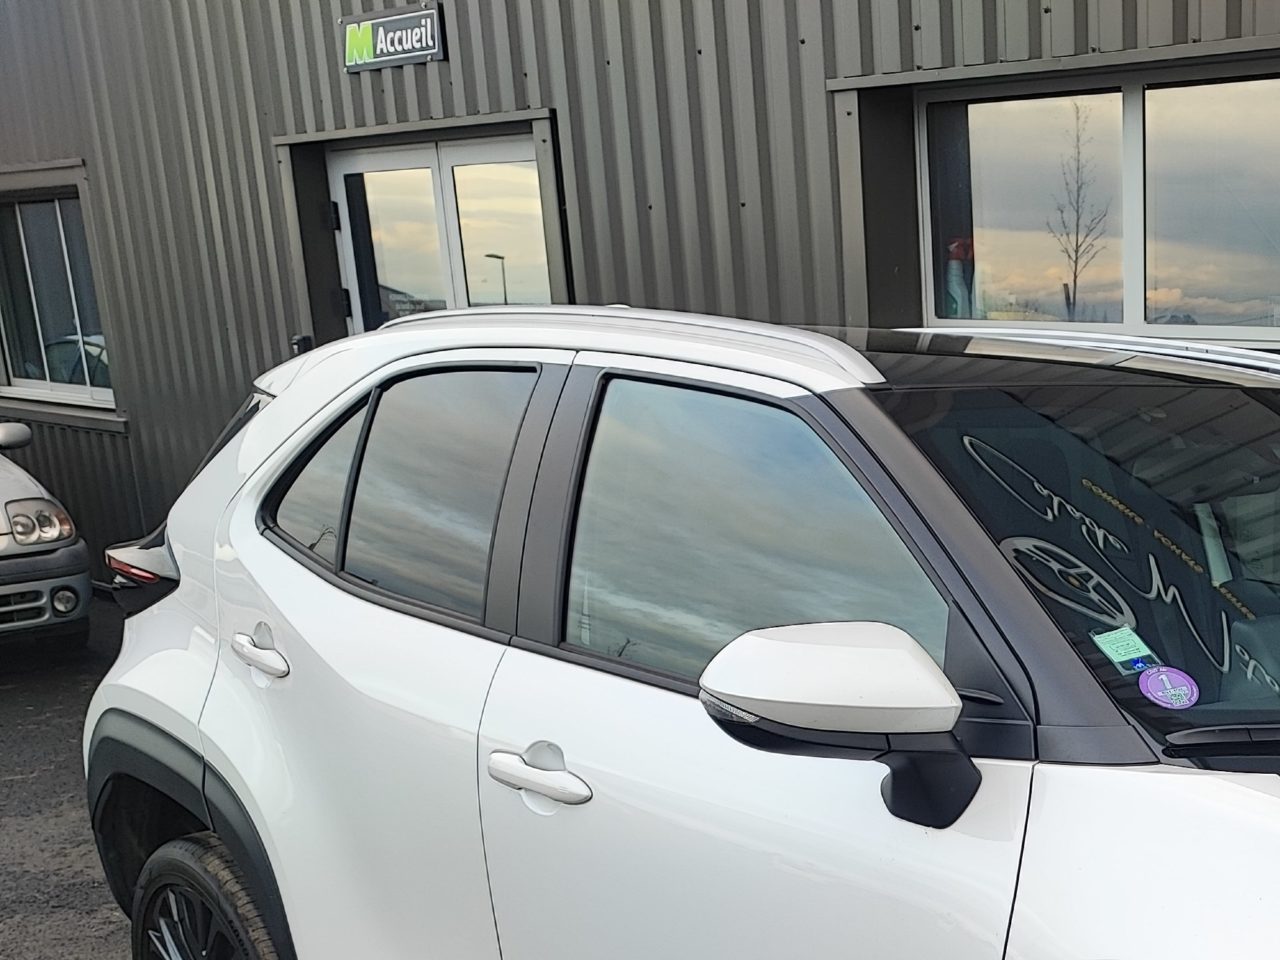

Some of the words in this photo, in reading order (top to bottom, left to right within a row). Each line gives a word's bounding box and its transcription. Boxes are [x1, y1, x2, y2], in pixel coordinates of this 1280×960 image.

[345, 22, 374, 66] M
[376, 18, 434, 55] Accueil
[1158, 674, 1172, 689] 1
